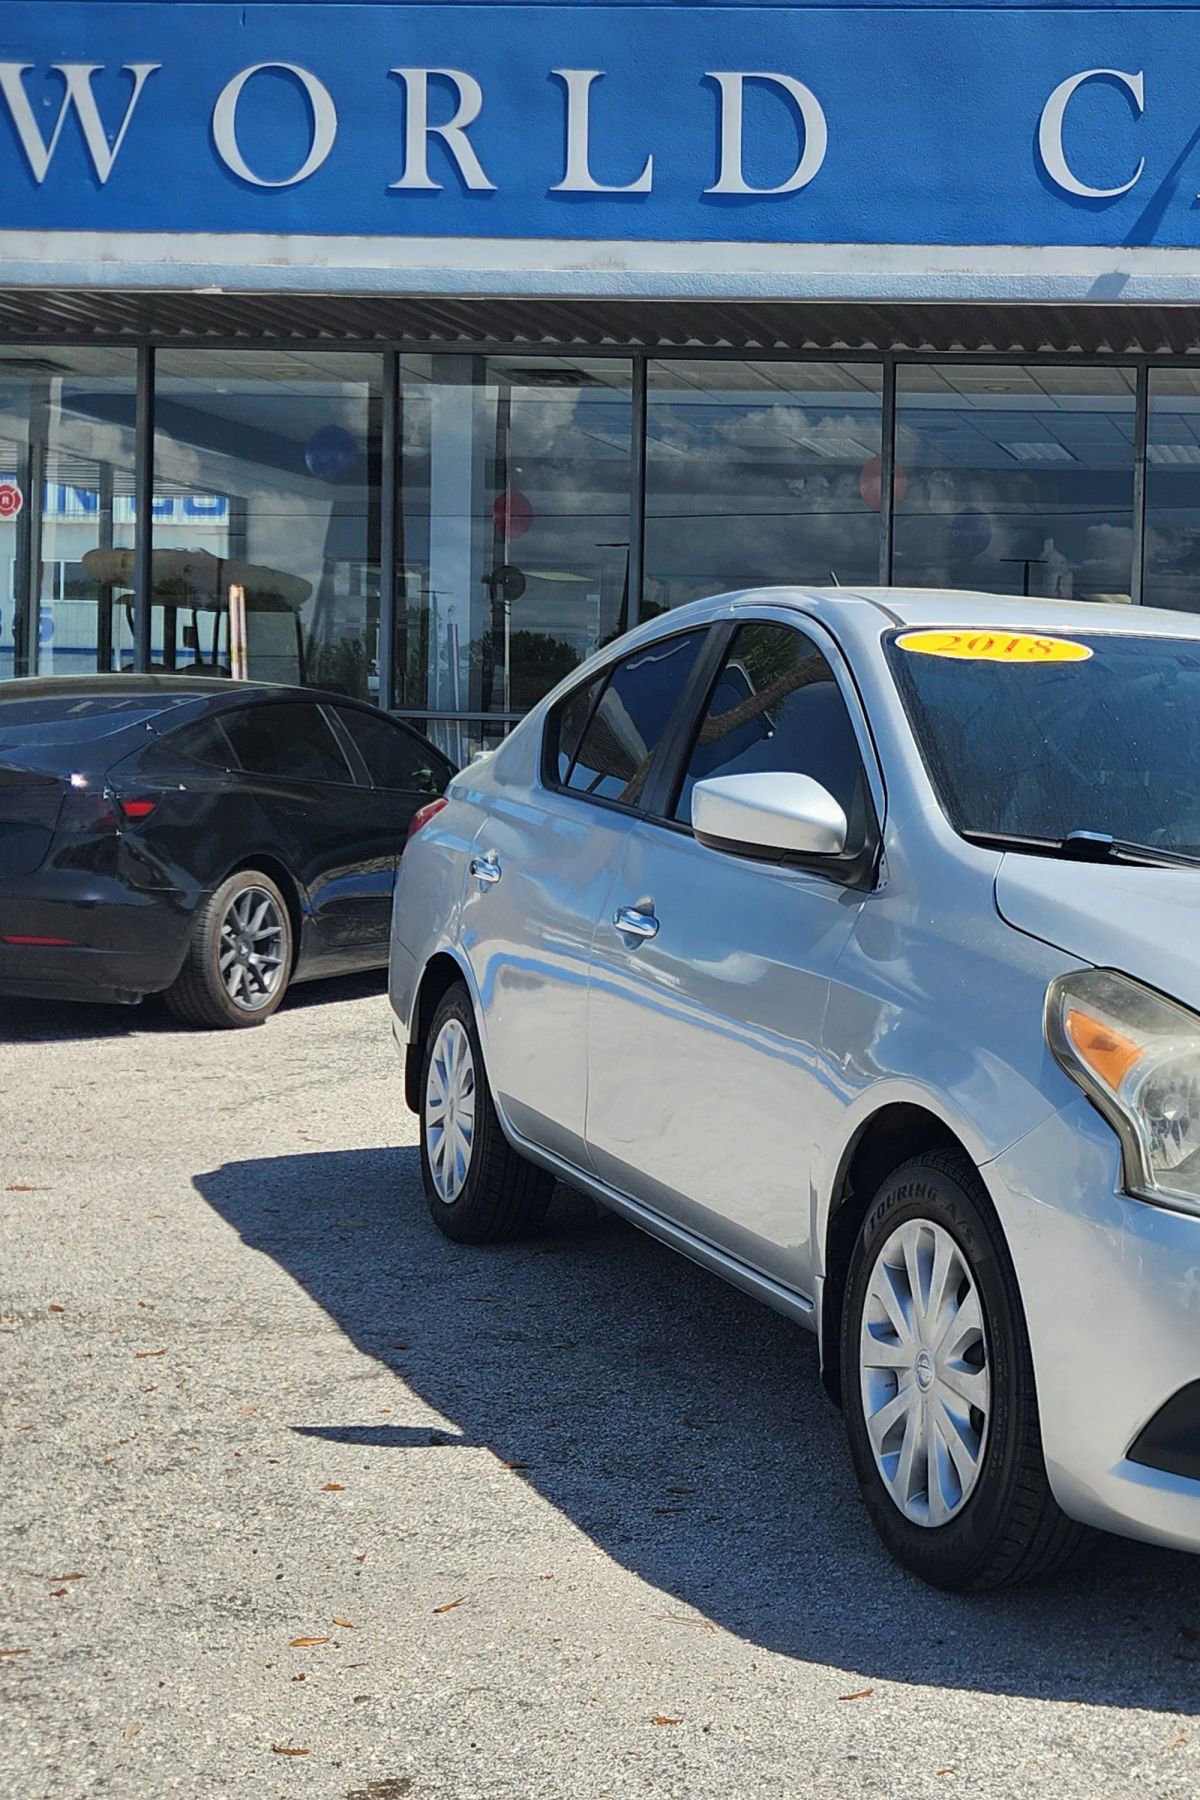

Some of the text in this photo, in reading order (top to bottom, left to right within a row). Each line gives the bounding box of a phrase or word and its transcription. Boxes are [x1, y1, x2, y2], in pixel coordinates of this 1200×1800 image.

[0, 61, 828, 195] WORLD
[936, 636, 1055, 655] 2018
[869, 1183, 938, 1230] TOURING
